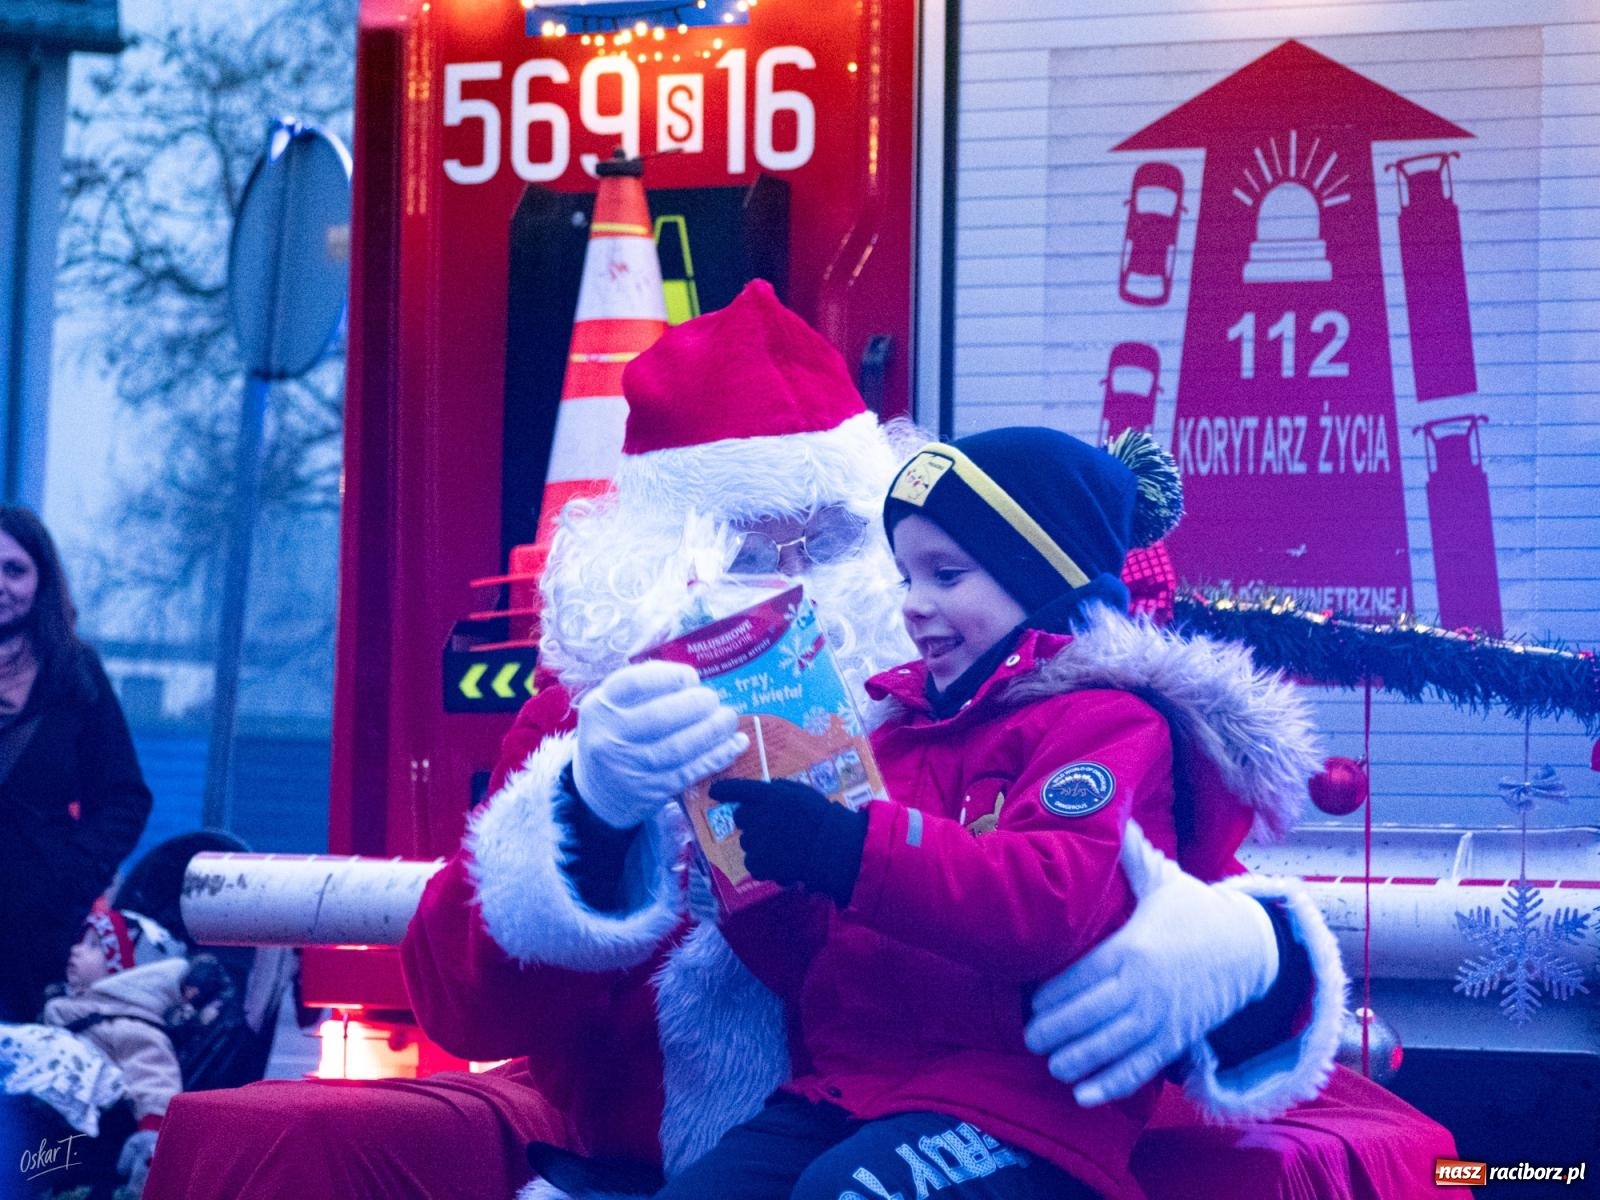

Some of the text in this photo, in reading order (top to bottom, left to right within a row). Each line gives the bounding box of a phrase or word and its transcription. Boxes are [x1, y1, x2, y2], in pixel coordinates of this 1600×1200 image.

[442, 55, 641, 185] 569
[714, 44, 818, 175] 16
[1225, 309, 1350, 380] 112
[1178, 400, 1391, 477] KORYTARZ ŻYCIA
